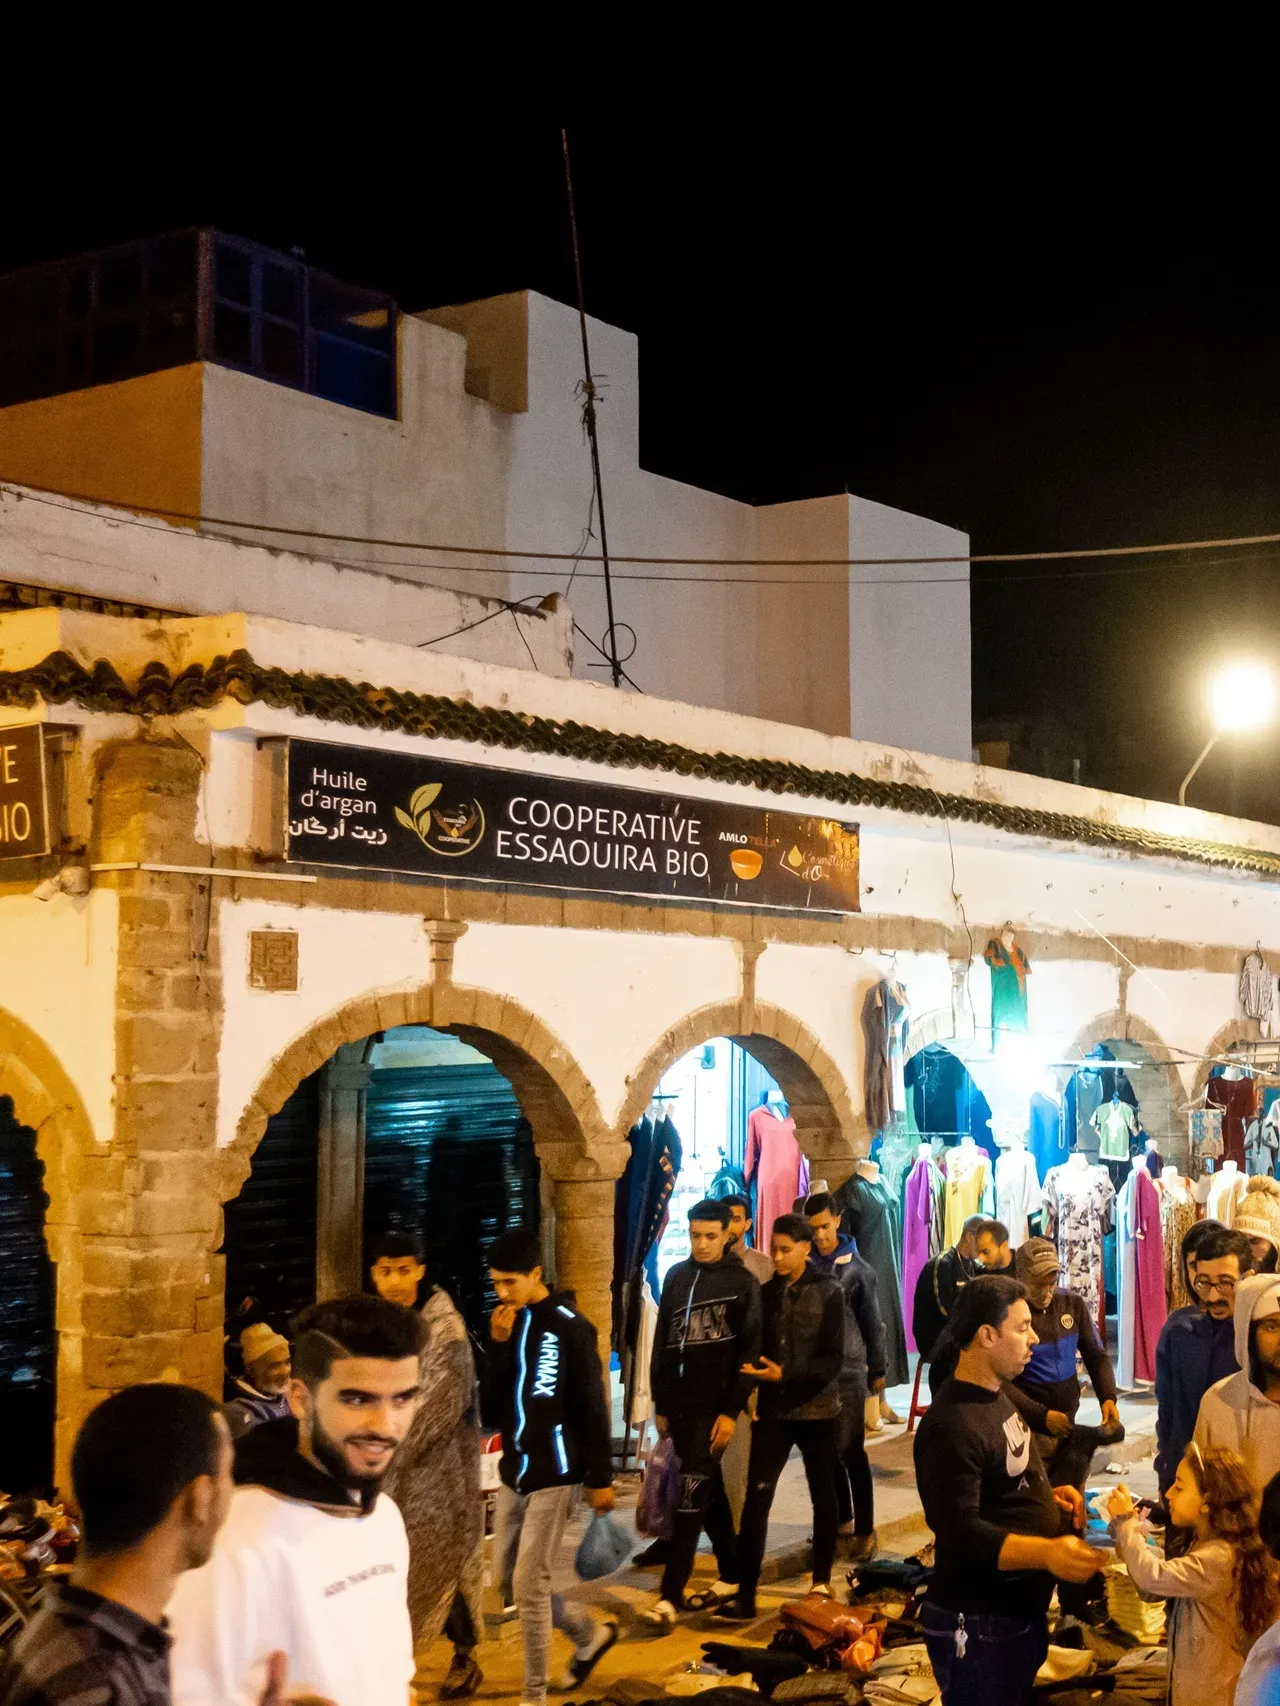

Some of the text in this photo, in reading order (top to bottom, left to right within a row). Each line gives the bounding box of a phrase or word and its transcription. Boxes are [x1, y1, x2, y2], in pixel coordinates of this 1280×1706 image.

[312, 767, 368, 792] Huile
[301, 789, 377, 817] d'argan
[0, 801, 31, 843] IO
[351, 825, 388, 846] زيت
[508, 796, 702, 846] COOPERATIVE
[718, 831, 748, 845] AMLO
[495, 830, 710, 879] ESSAOUIRA BIO
[532, 1331, 560, 1398] AIRMAX
